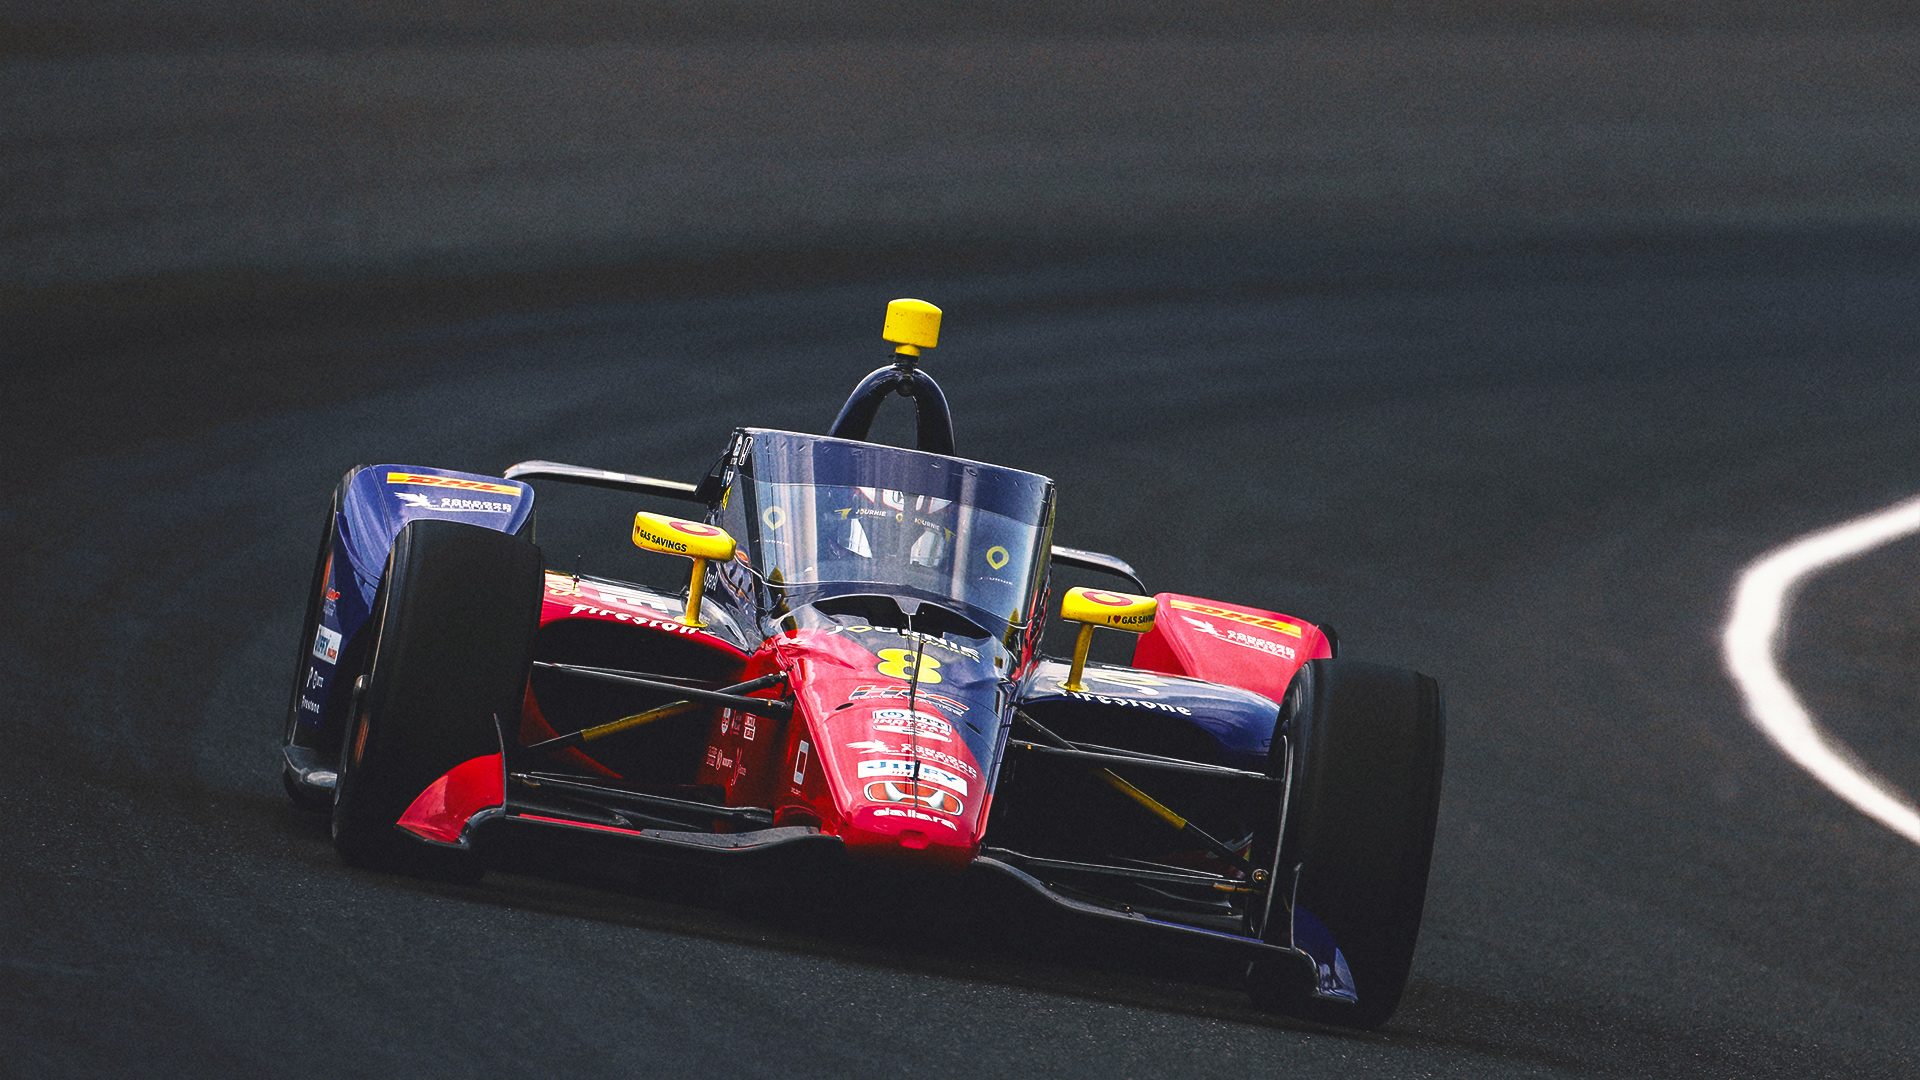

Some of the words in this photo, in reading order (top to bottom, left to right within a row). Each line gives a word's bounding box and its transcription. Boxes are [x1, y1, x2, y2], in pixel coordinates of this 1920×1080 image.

[405, 475, 498, 492] DHL
[856, 508, 887, 517] JOURNIE
[640, 529, 652, 541] GAS
[651, 534, 688, 553] SAVINGS
[1121, 615, 1138, 625] GAS
[1192, 606, 1284, 631] DHL
[876, 647, 943, 685] 8
[873, 807, 958, 832] dallara
